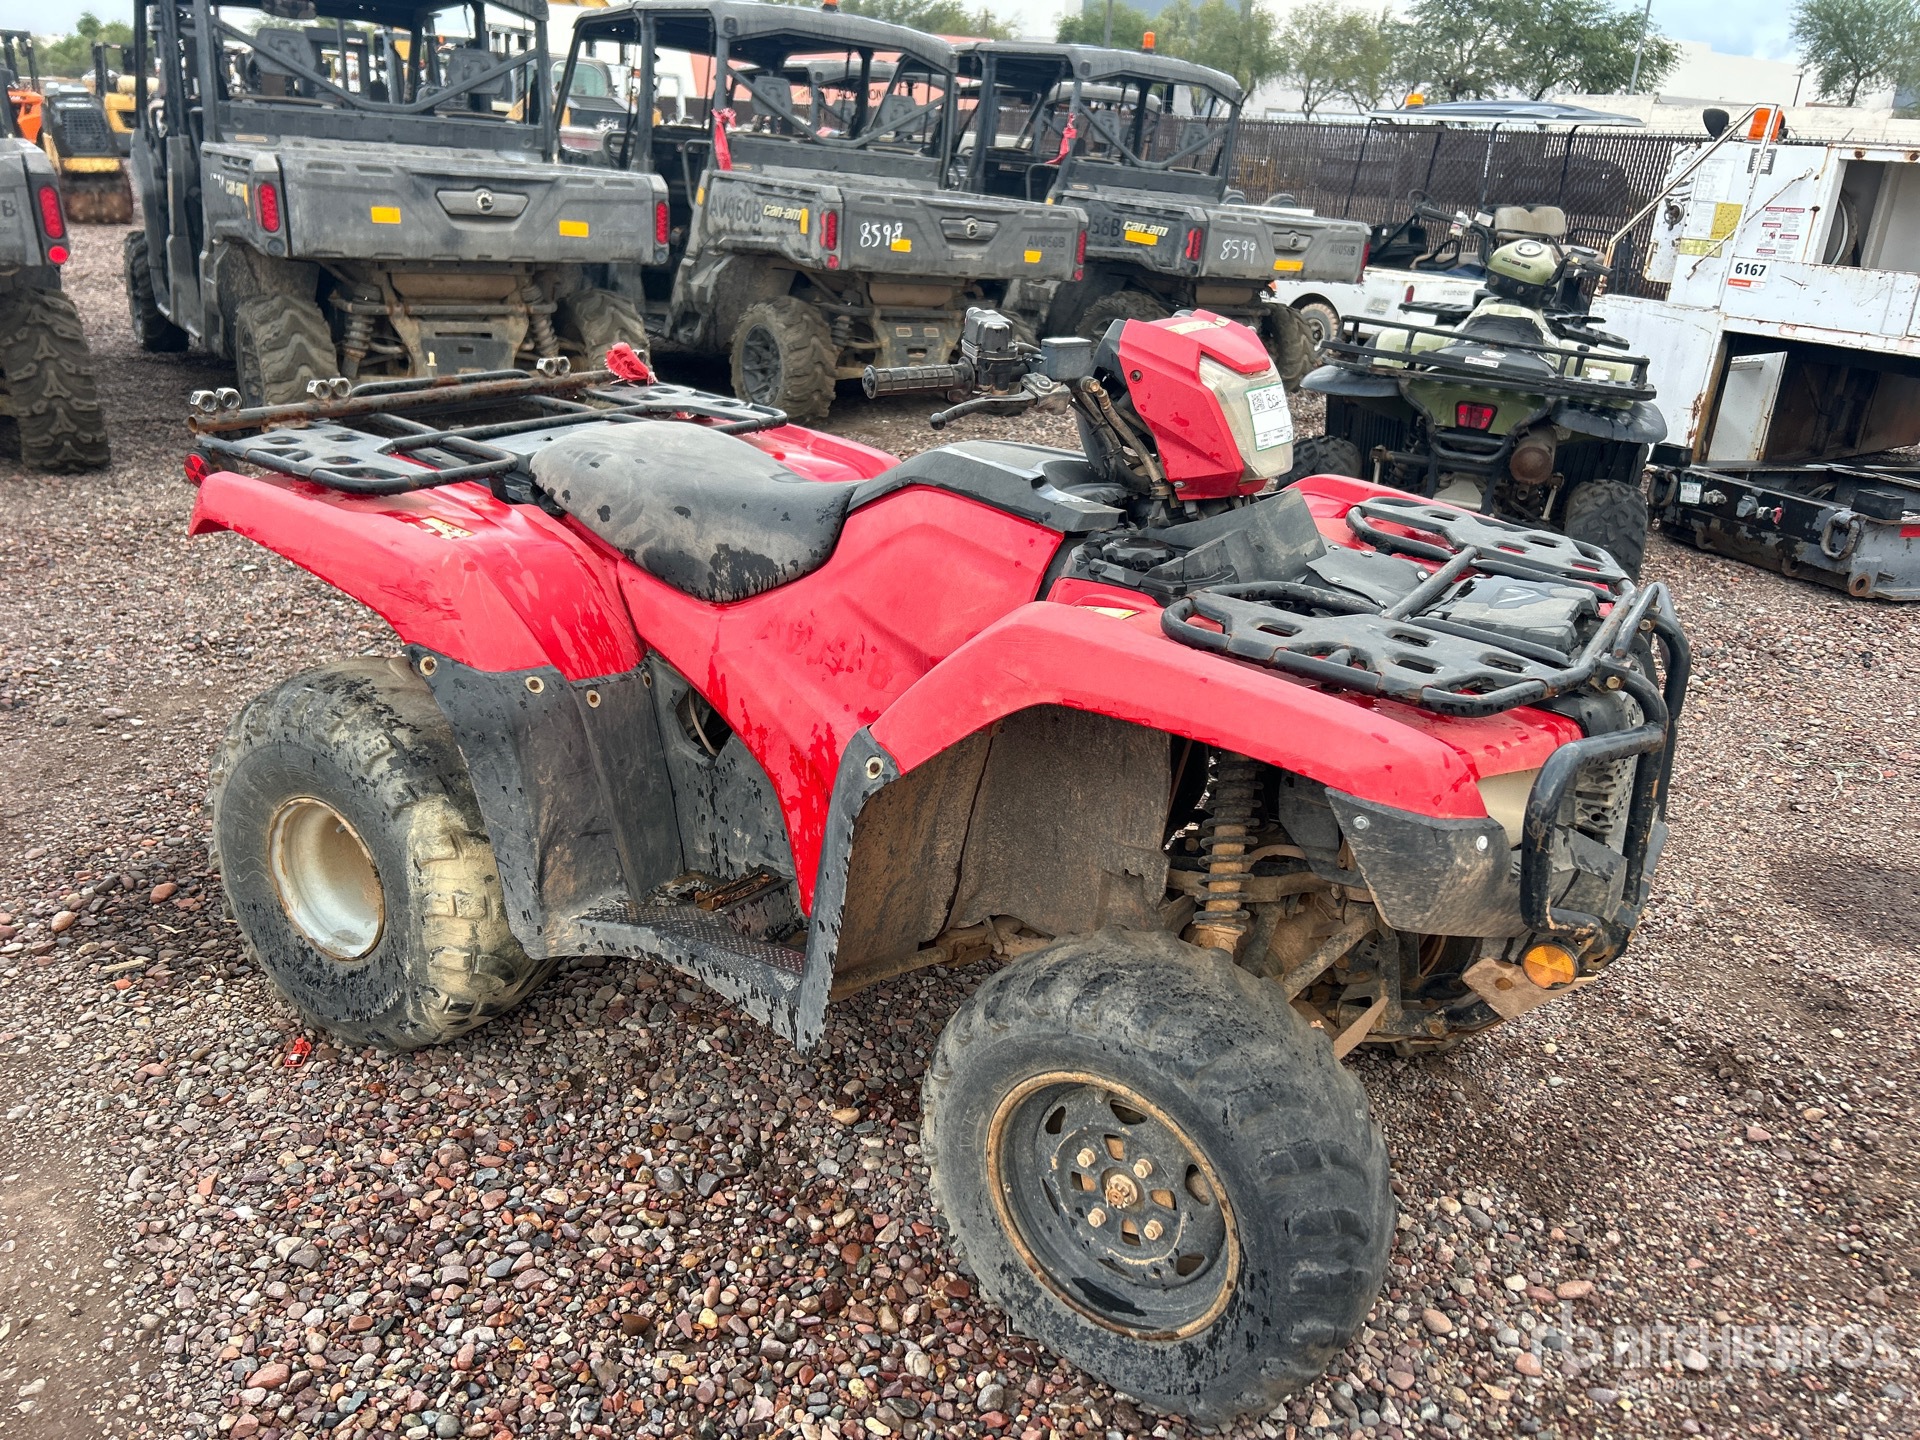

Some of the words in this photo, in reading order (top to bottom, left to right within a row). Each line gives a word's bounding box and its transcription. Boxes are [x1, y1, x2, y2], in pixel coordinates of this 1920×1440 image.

[762, 204, 801, 221] can-am
[859, 222, 904, 248] 8598
[1122, 220, 1169, 237] can-am
[1219, 239, 1256, 264] 8599
[1735, 262, 1767, 277] 6167
